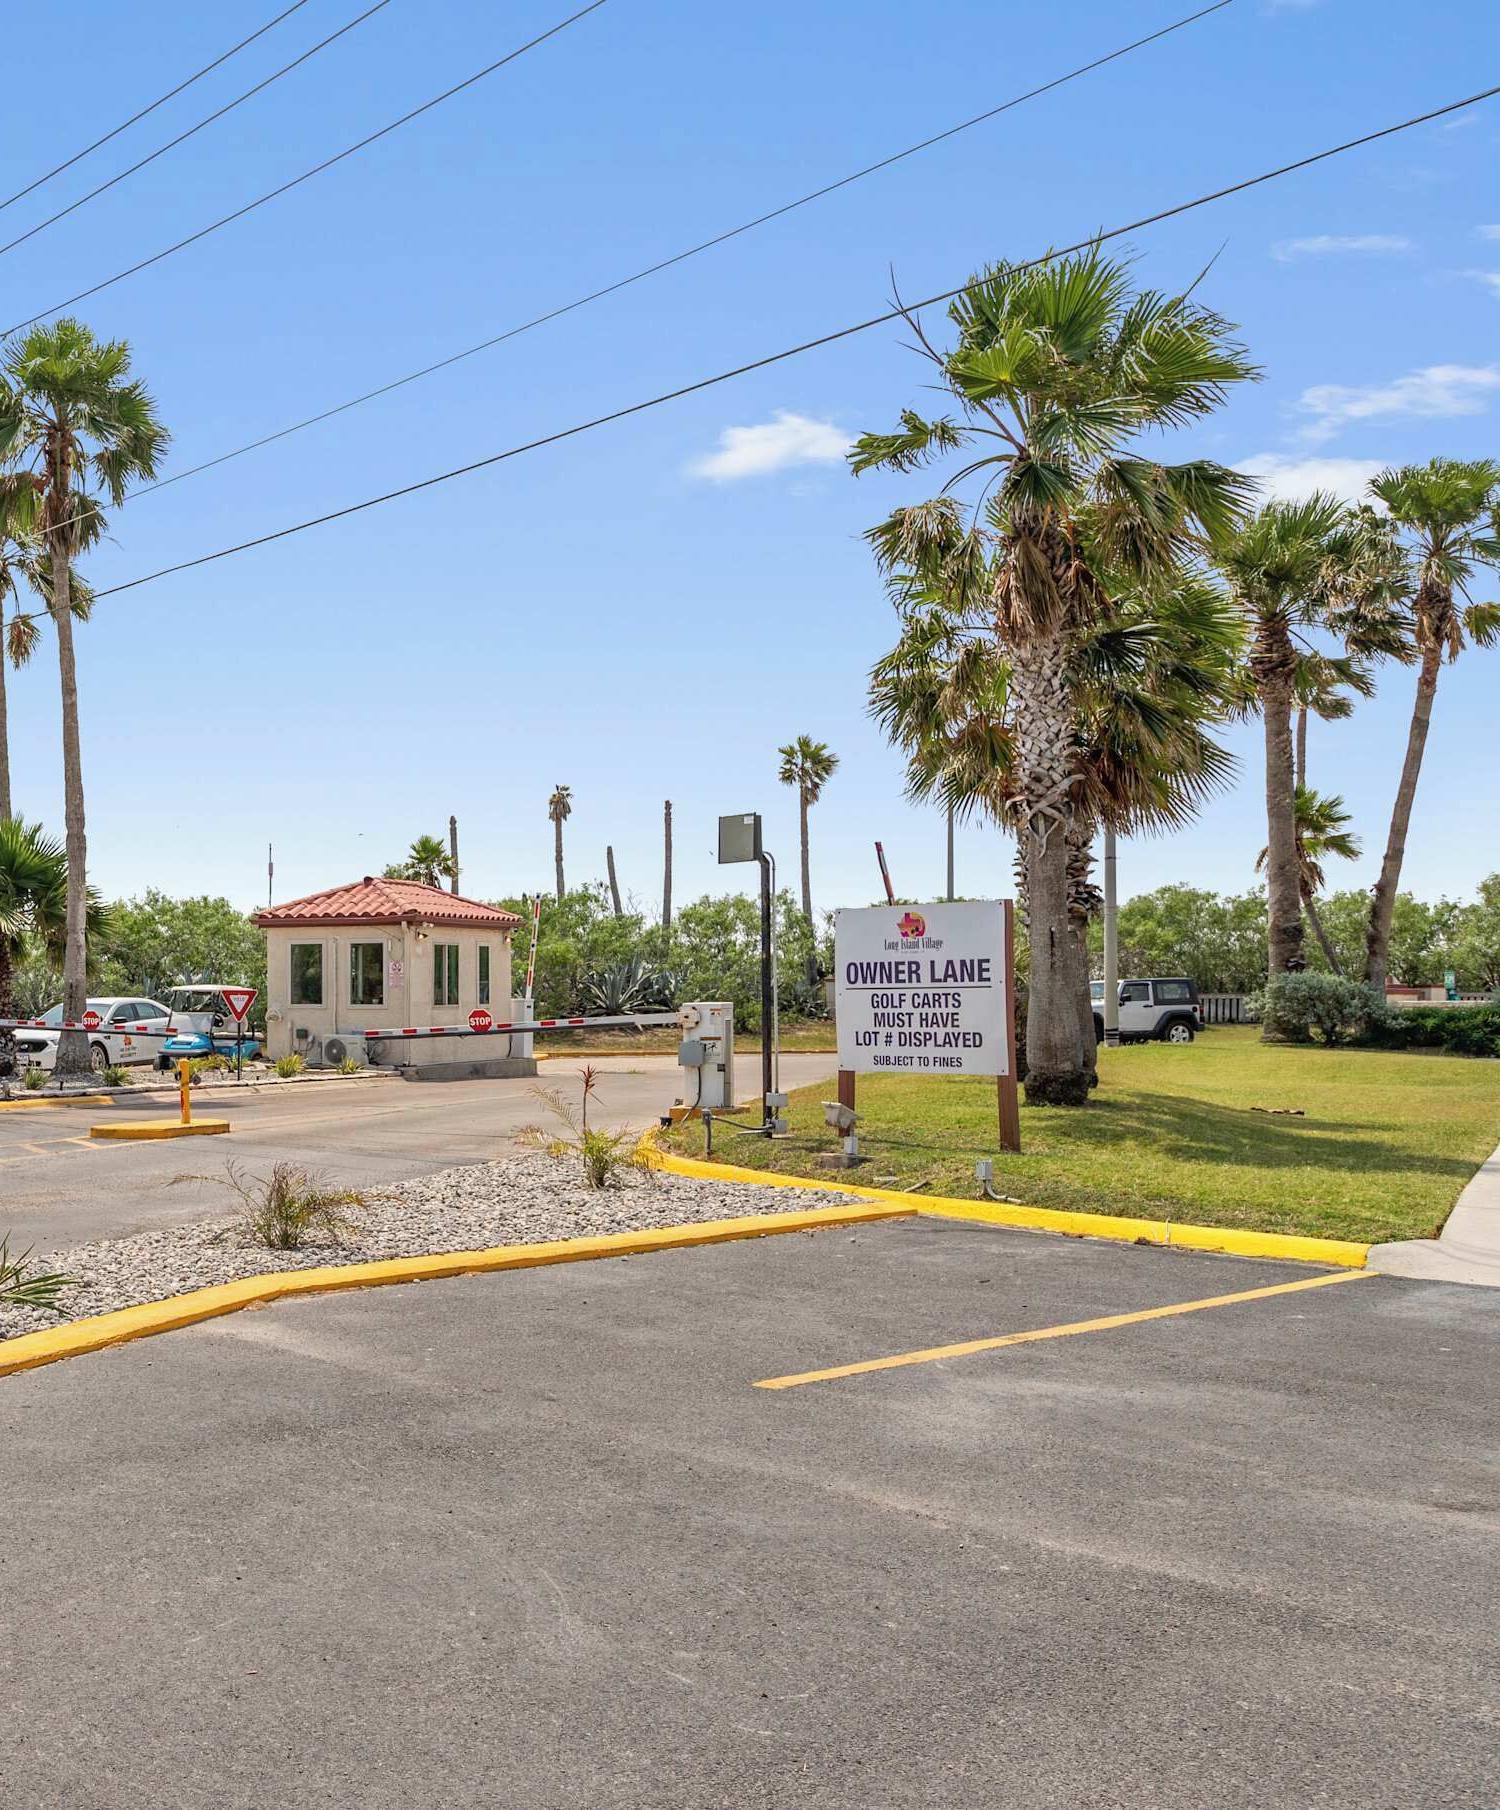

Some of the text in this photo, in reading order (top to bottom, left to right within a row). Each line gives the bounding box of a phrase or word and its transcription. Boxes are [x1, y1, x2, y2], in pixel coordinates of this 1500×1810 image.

[884, 937, 943, 951] Long Island Village
[846, 958, 991, 985] OWNER LANE
[871, 992, 962, 1009] GOLF CARTS
[83, 1017, 99, 1025] STOP
[469, 1016, 491, 1026] STOP
[873, 1012, 960, 1028] MUST HAVE
[855, 1031, 983, 1048] LOT # DISPLAYED
[873, 1055, 963, 1068] SUBJECT TO FINES
